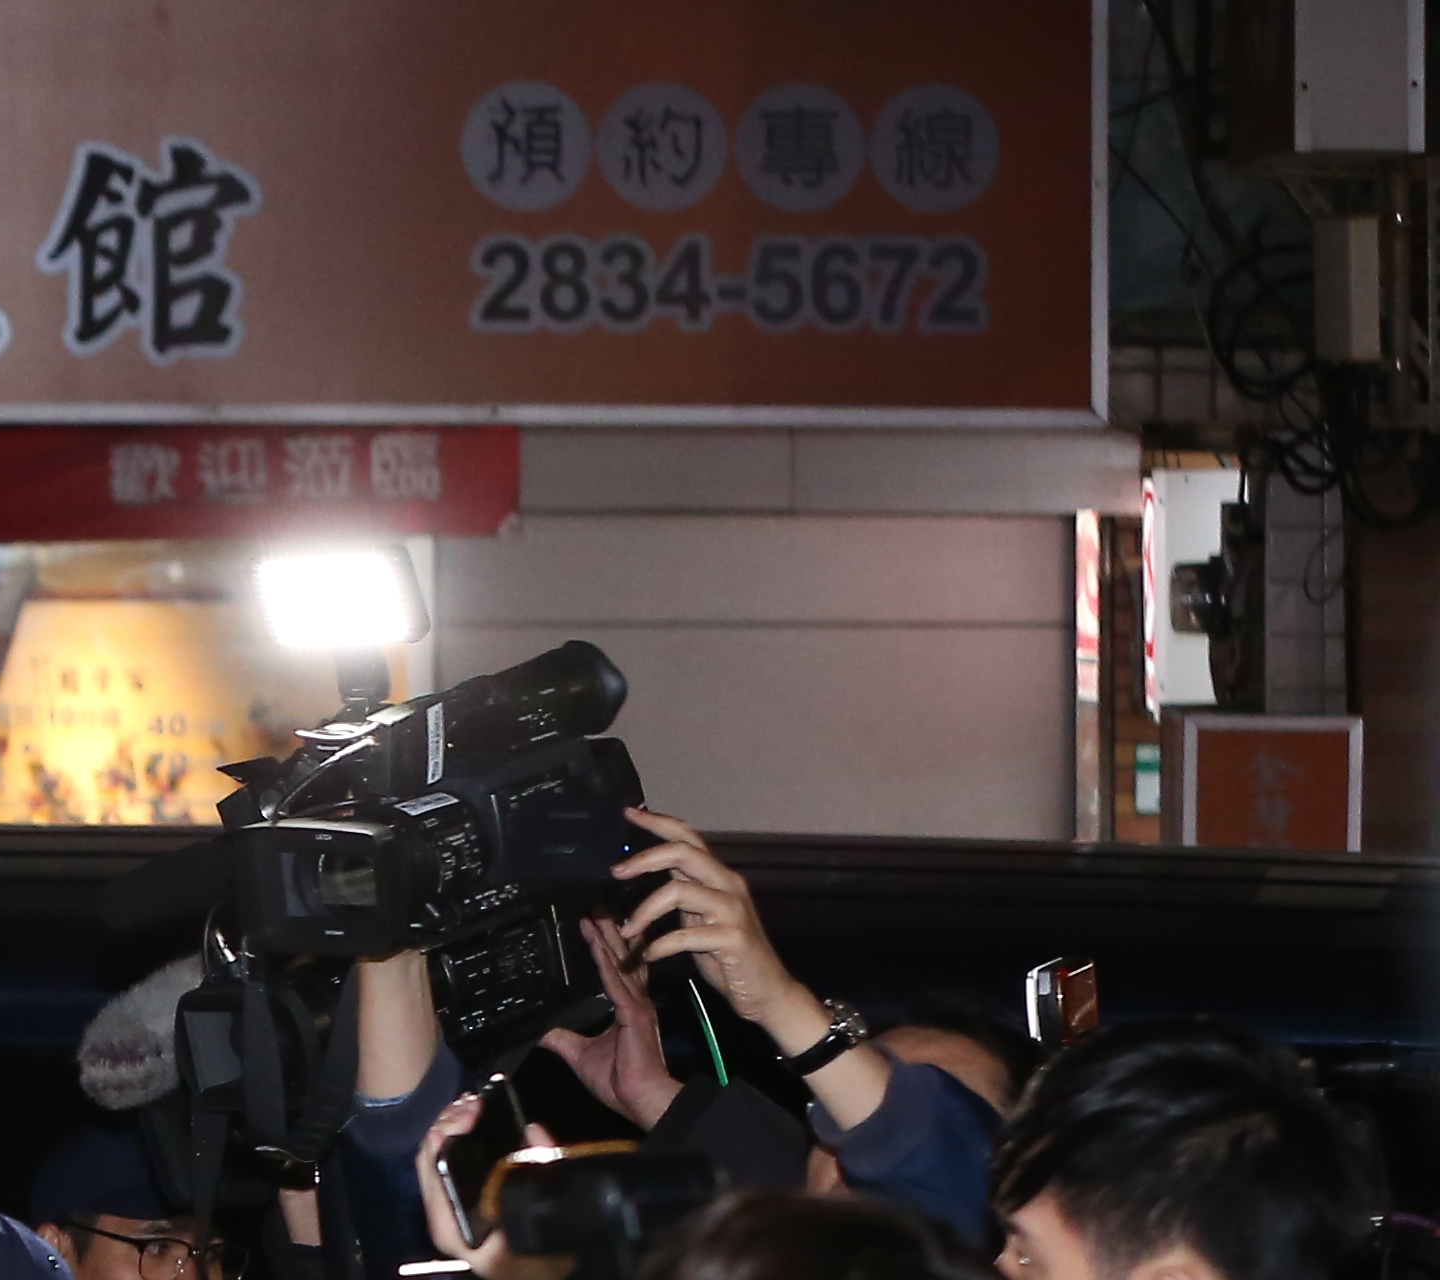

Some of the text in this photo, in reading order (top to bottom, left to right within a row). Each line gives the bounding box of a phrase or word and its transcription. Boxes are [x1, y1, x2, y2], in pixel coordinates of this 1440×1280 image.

[486, 97, 975, 190] 預約專線
[476, 238, 984, 328] 2834-5672
